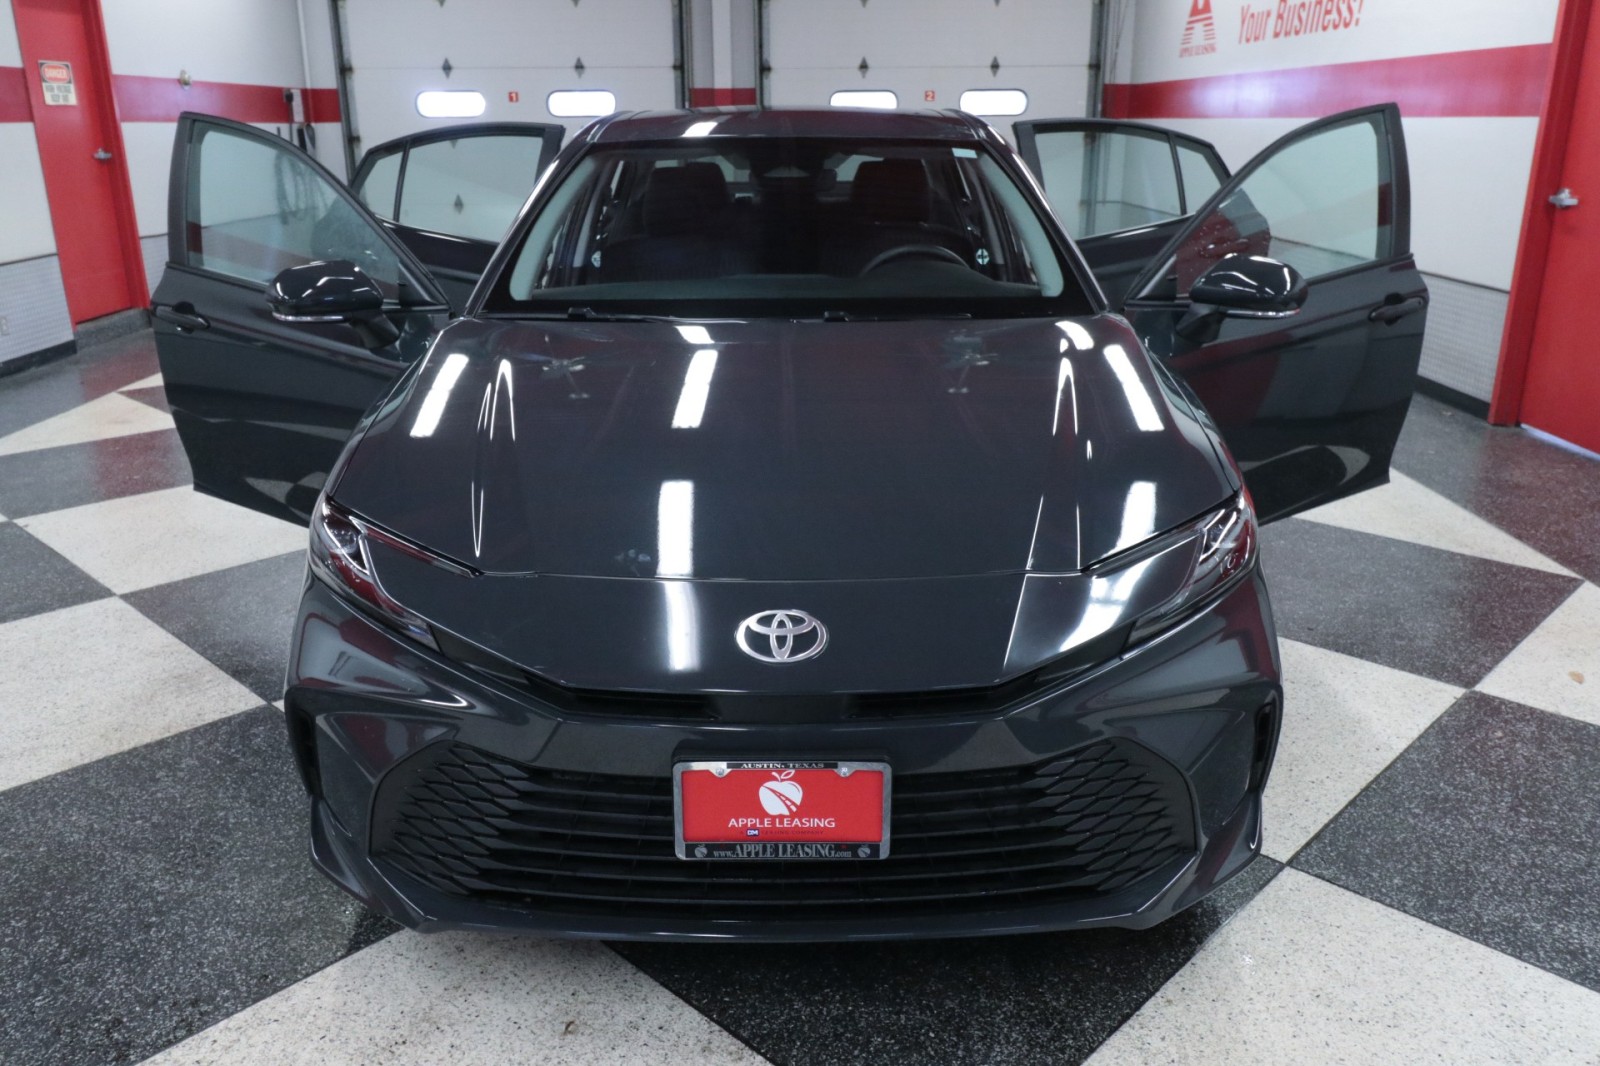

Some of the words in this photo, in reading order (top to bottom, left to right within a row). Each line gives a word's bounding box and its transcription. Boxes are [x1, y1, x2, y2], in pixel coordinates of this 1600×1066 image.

[1238, 5, 1271, 44] Your
[1273, 0, 1364, 39] Business!
[728, 818, 772, 828] APPLE
[776, 818, 836, 828] LEASING
